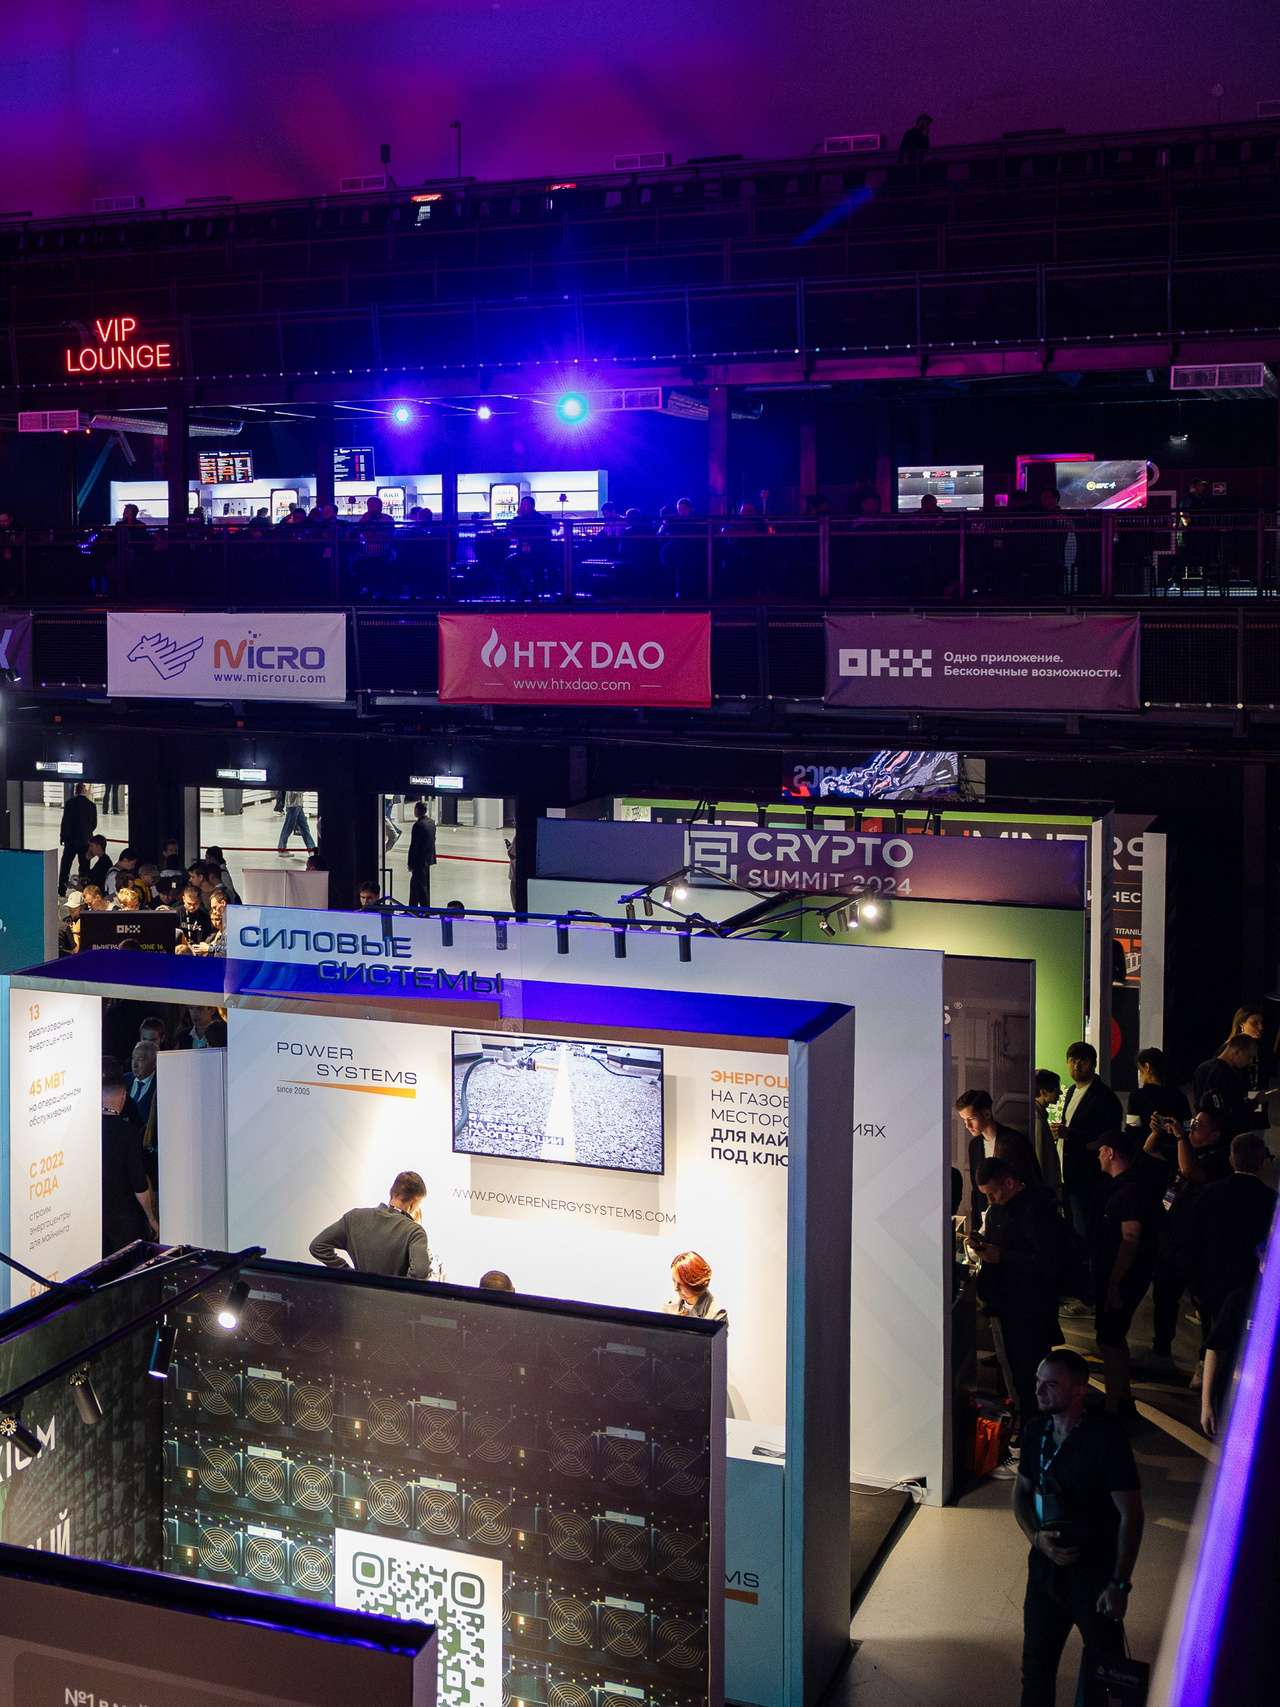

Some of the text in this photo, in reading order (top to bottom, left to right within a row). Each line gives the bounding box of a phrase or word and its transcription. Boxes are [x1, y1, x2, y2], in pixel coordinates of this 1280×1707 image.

[96, 318, 136, 342] VIP
[66, 344, 171, 371] LOUNGE
[513, 641, 665, 669] HTX DAO
[944, 652, 1063, 664] Одно приложение.
[214, 672, 326, 683] www.microru.com
[944, 666, 1121, 678] Бесконечные возможности.
[513, 678, 631, 691] www.htxdao.com
[748, 832, 914, 869] CRYPTO
[748, 868, 913, 895] SUMMIT 2024
[239, 926, 412, 959] СИЛОВЫЕ
[317, 959, 502, 993] СИСТЕМЫ
[28, 1004, 41, 1021] 13
[277, 1041, 353, 1061] POWER
[28, 1070, 67, 1096] 45 МВТ
[317, 1063, 418, 1085] SYSTEMS
[276, 1085, 311, 1095] since 2005
[711, 1089, 735, 1104] НА
[711, 1127, 746, 1144] ДЛЯ
[40, 1150, 64, 1175] 2022
[711, 1146, 748, 1165] ПОД
[29, 1174, 59, 1200] ГОДА
[29, 1206, 52, 1222] строим
[29, 1210, 72, 1236] энергоцентры
